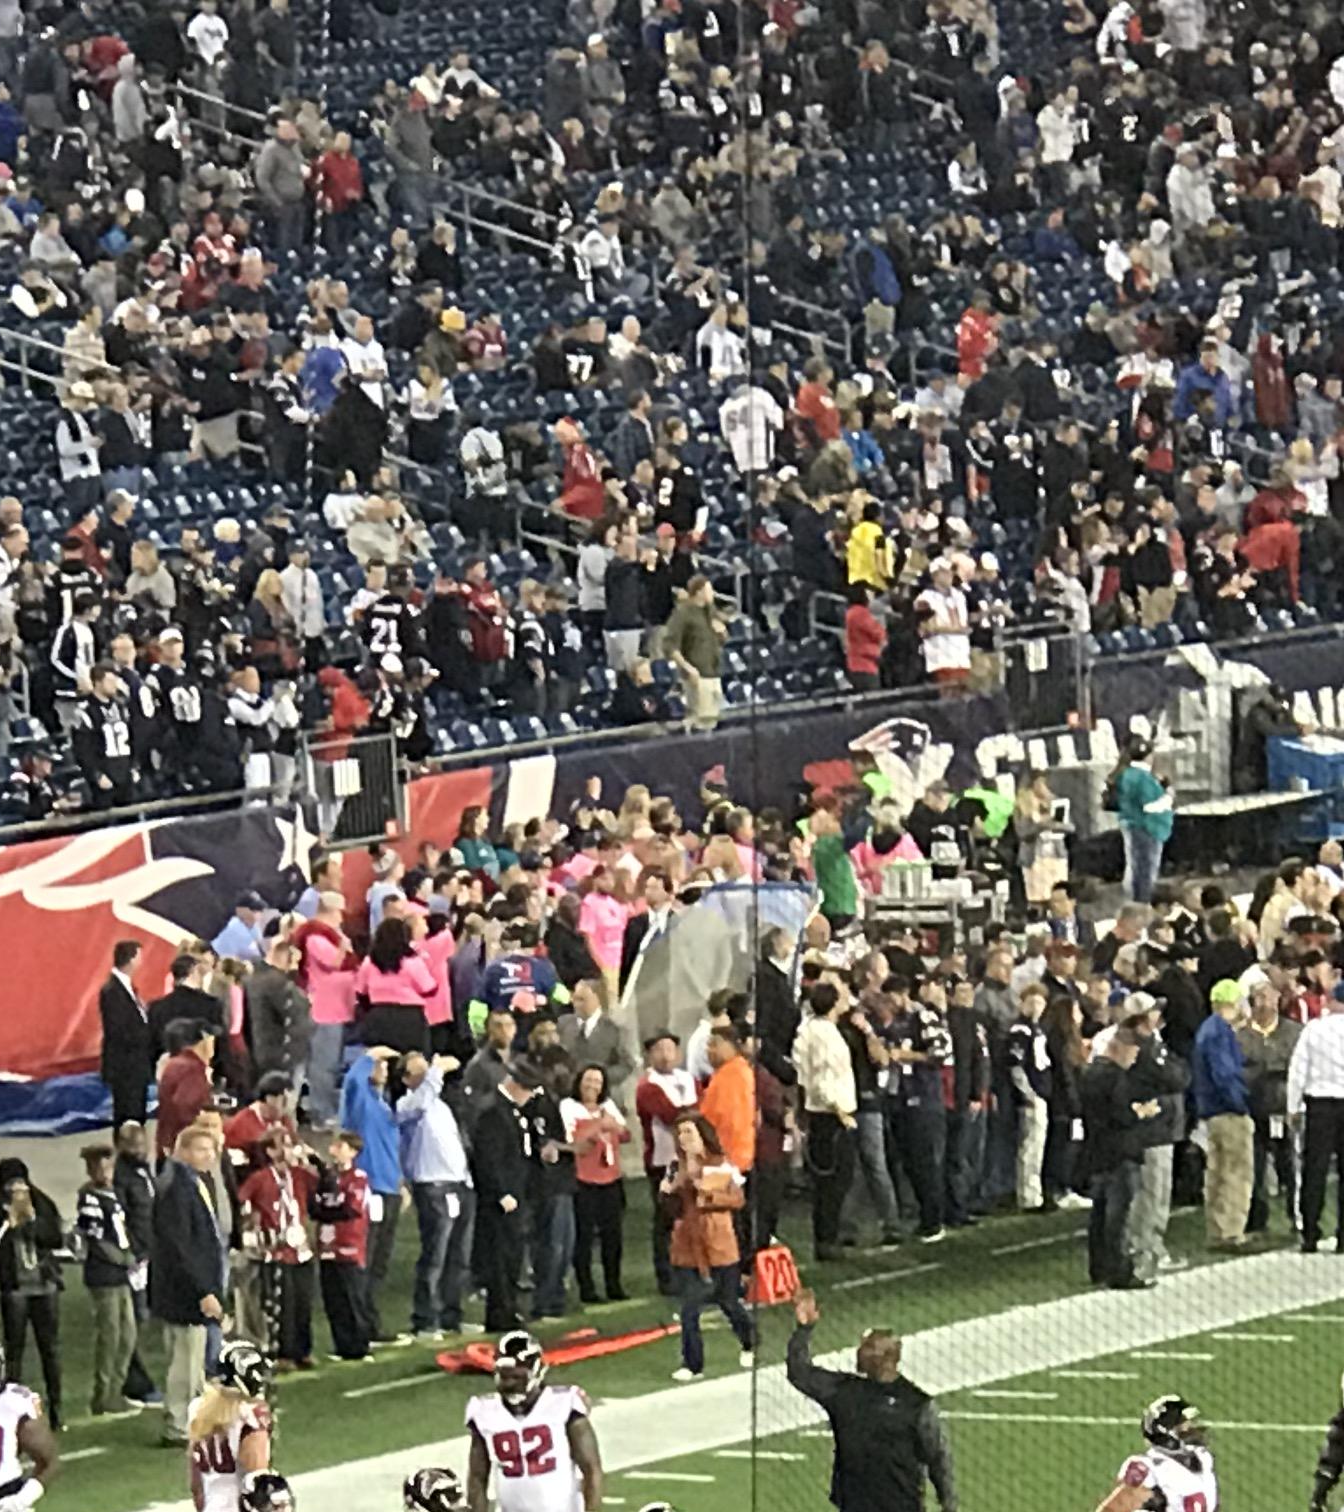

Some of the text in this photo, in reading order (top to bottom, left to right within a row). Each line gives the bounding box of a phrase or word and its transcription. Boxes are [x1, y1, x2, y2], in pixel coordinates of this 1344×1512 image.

[370, 617, 402, 654] 21
[101, 720, 132, 759] 12
[763, 1252, 796, 1299] 20
[492, 1423, 557, 1479] 92
